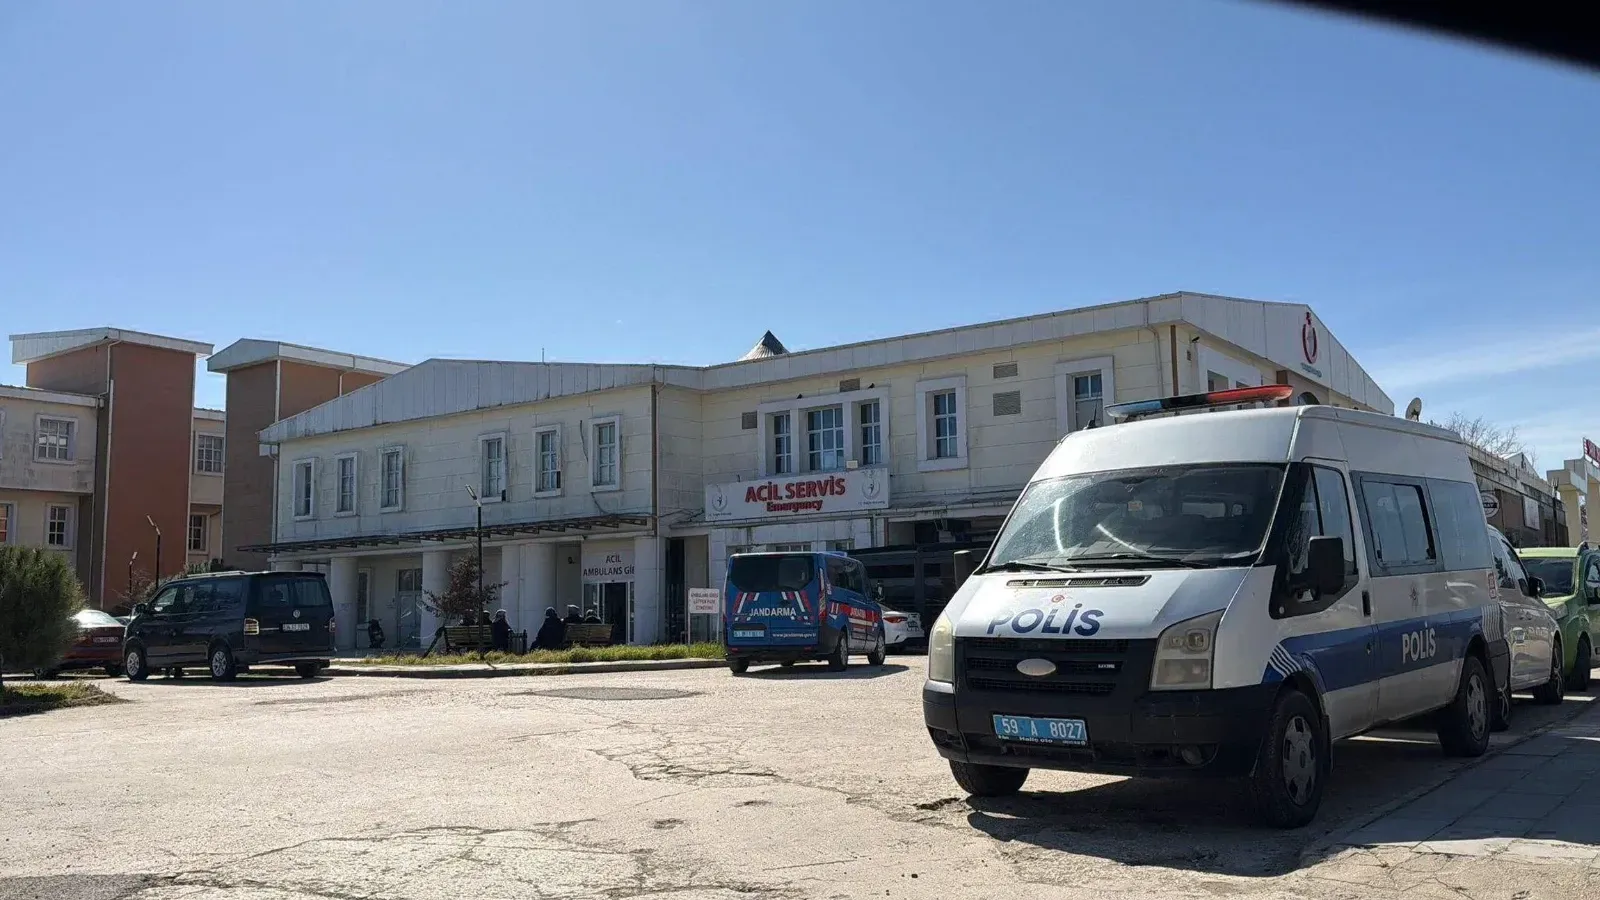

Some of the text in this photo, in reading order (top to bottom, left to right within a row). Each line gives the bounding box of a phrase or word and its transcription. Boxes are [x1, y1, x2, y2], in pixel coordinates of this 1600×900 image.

[745, 476, 846, 503] ACİL SERVİS
[766, 500, 823, 512] Emergency
[583, 567, 623, 577] AMBULANS
[749, 607, 797, 617] JANDARMA
[987, 603, 1104, 637] POLİS
[1402, 620, 1437, 665] POLİS
[1001, 718, 1083, 739] 59 A 8027
